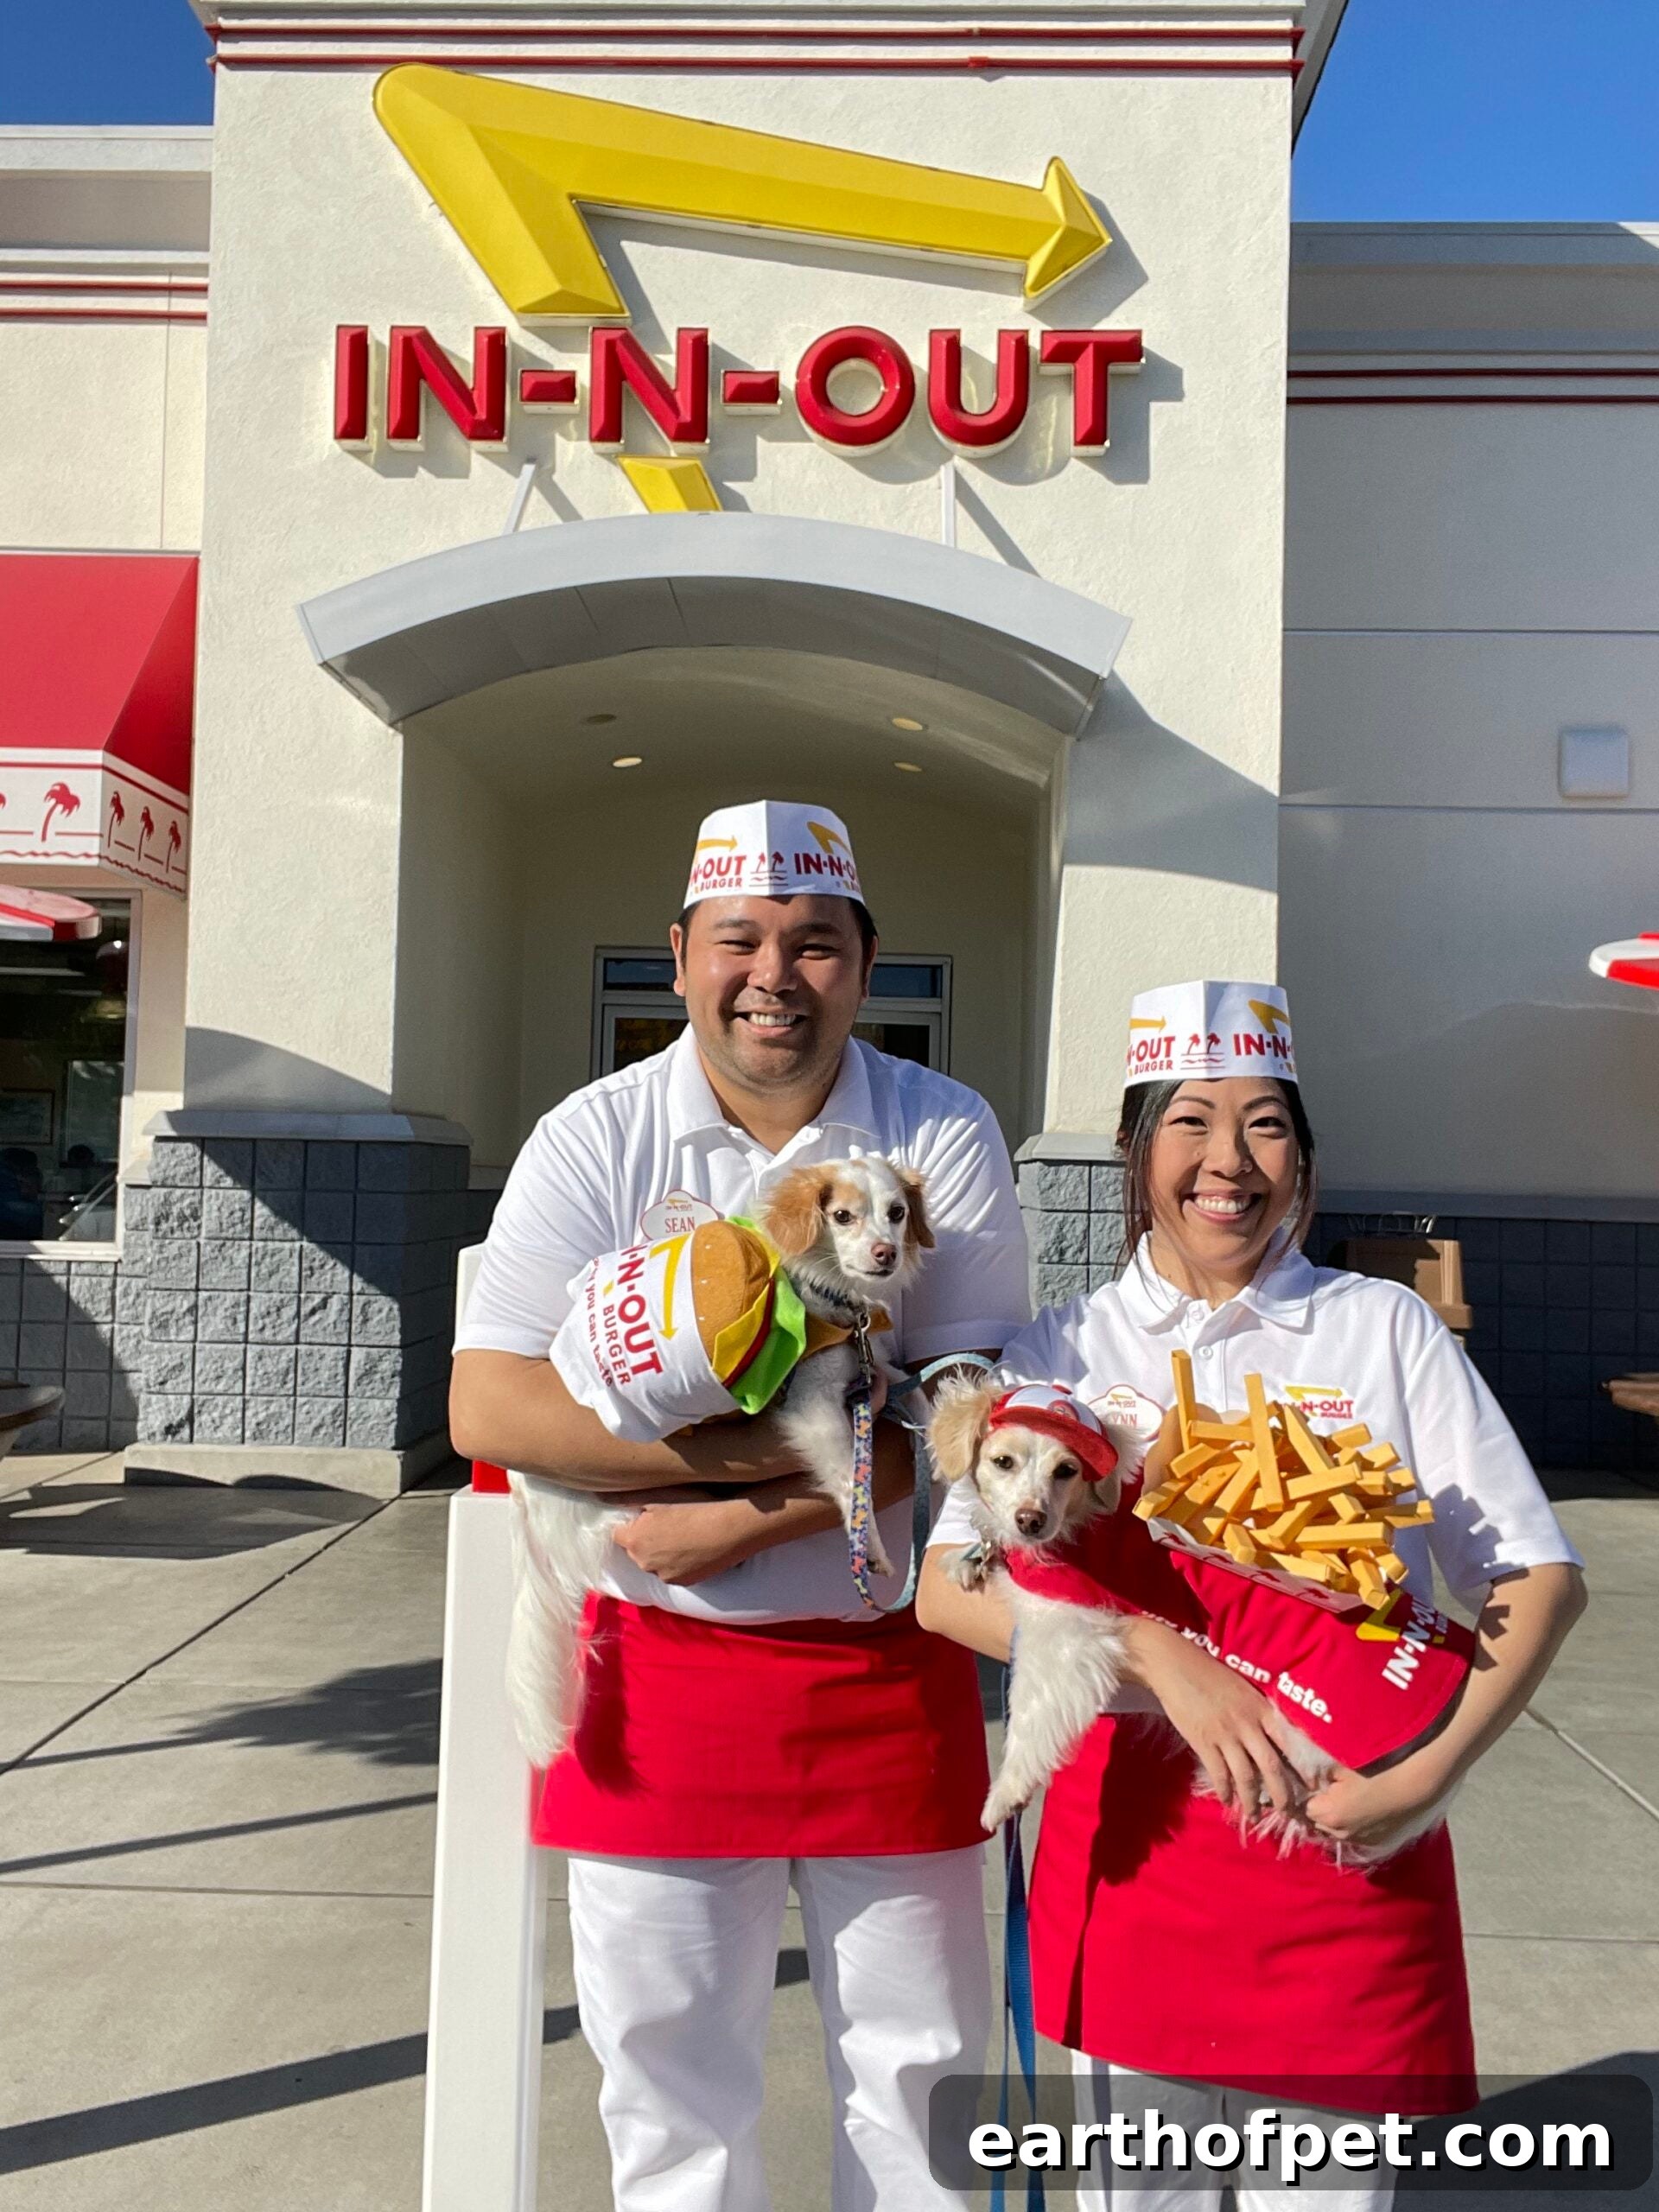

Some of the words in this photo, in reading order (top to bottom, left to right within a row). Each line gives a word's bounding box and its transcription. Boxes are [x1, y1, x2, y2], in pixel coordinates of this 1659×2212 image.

[334, 324, 1144, 455] IN-N-OUT
[701, 878, 742, 892] BURGER
[1135, 1060, 1173, 1075] BURGER
[664, 1217, 696, 1233] SEAN
[588, 1313, 597, 1343] can
[602, 1303, 632, 1384] BURGER
[1225, 1654, 1271, 1683] can
[1277, 1671, 1332, 1723] taste.
